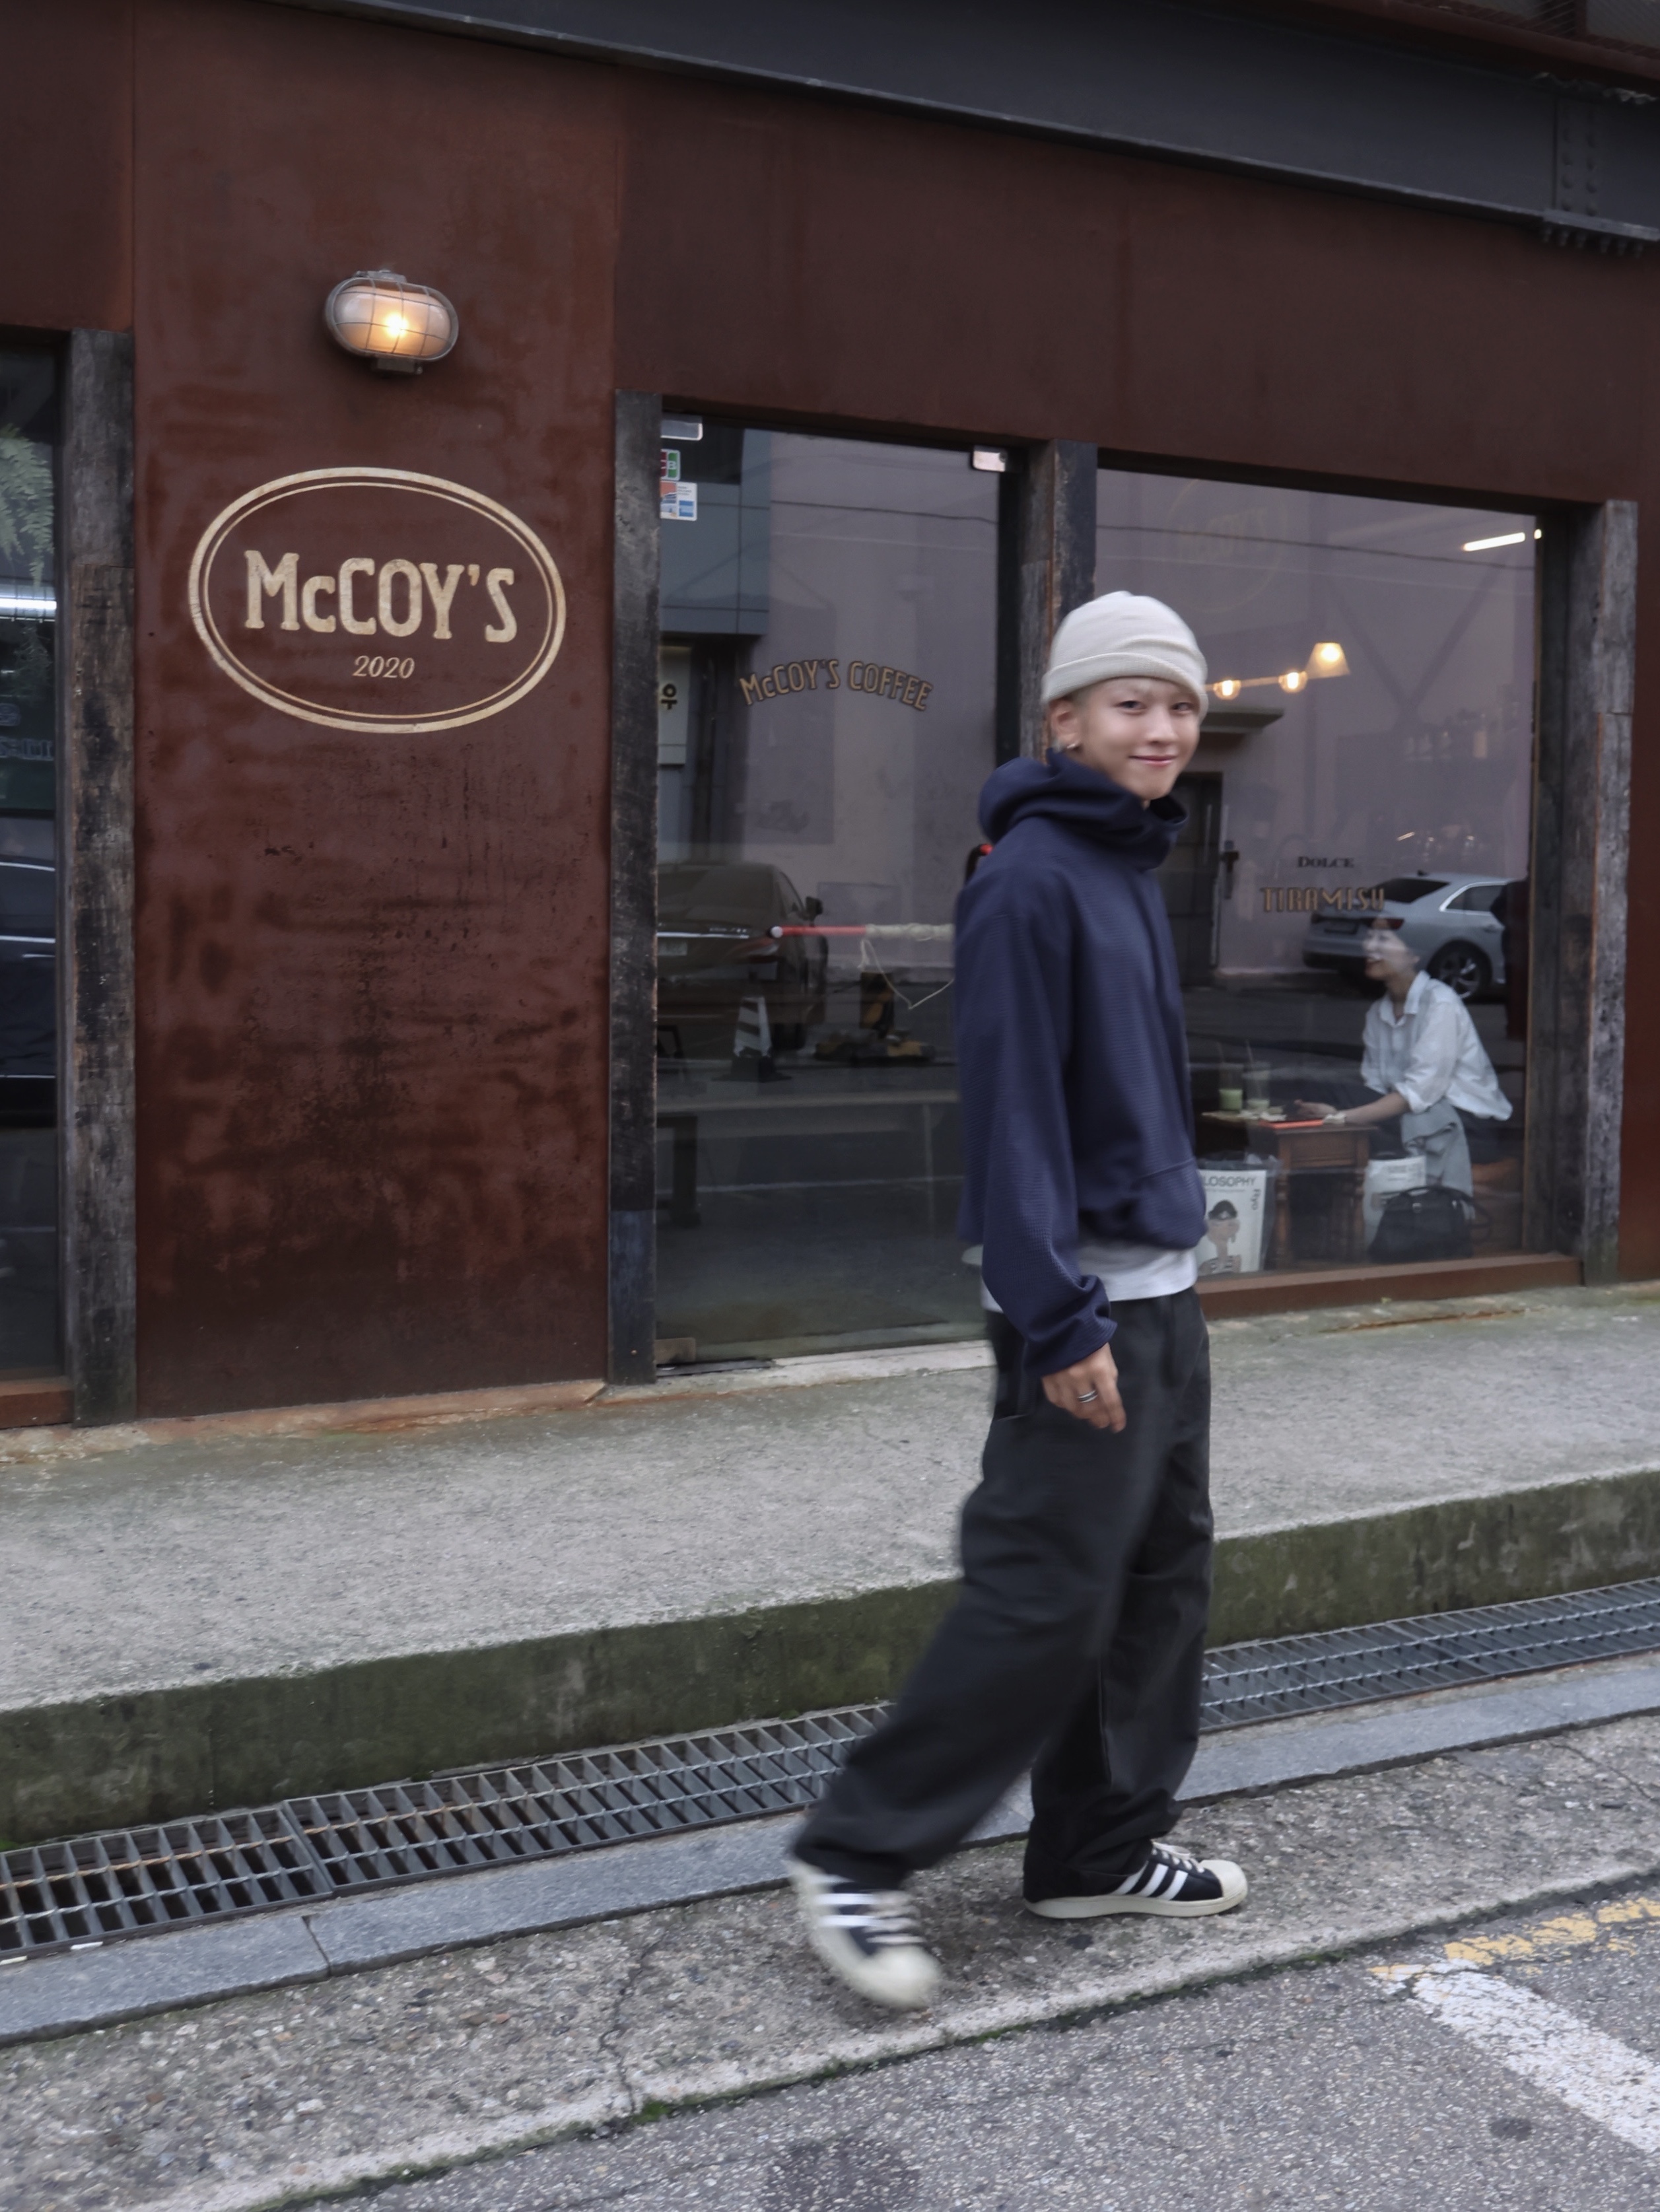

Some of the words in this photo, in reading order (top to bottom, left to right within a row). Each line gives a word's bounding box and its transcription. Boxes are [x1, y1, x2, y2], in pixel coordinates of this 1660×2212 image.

[244, 549, 518, 643] McCOY'S
[352, 655, 415, 679] 2020
[738, 659, 841, 707] McCOY'S
[848, 661, 934, 712] COFFEE
[1297, 856, 1355, 869] DOLCE
[1260, 887, 1386, 913] TIRAMISU
[1203, 1176, 1257, 1187] LOSOPHY
